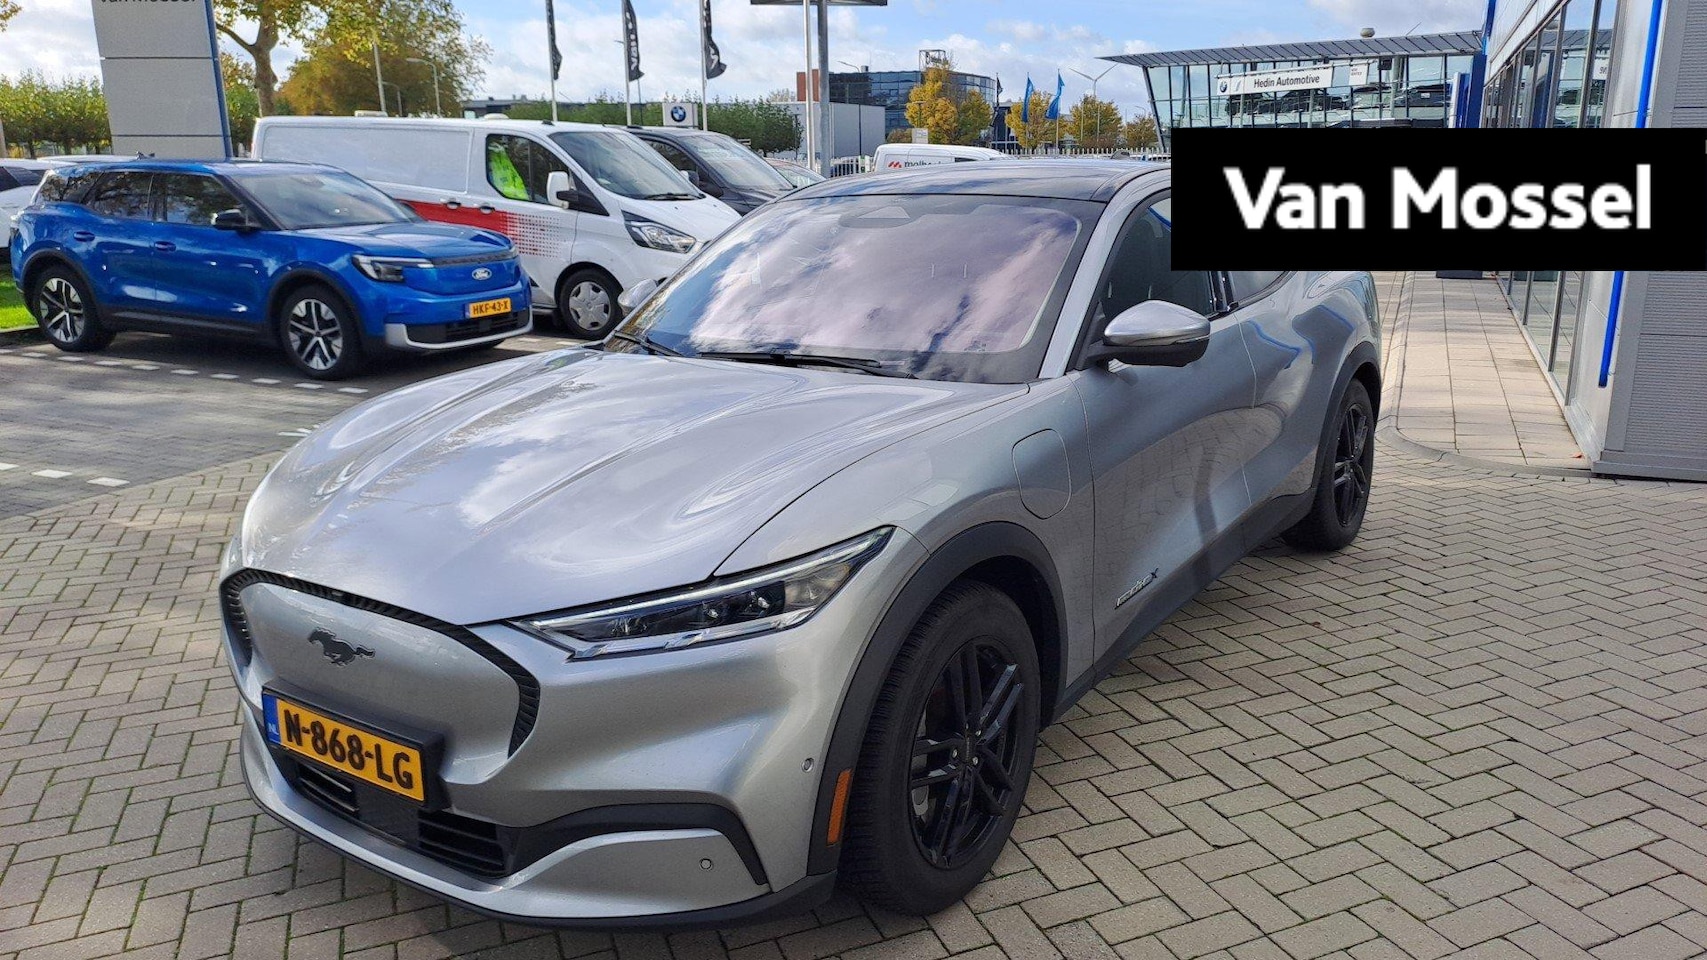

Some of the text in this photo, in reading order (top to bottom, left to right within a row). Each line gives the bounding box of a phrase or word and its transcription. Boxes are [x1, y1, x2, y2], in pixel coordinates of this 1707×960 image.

[1253, 73, 1320, 88] Hedin Automotive
[472, 300, 509, 315] HKF-43-X
[268, 722, 279, 736] NL
[284, 709, 413, 790] N-868-LG
